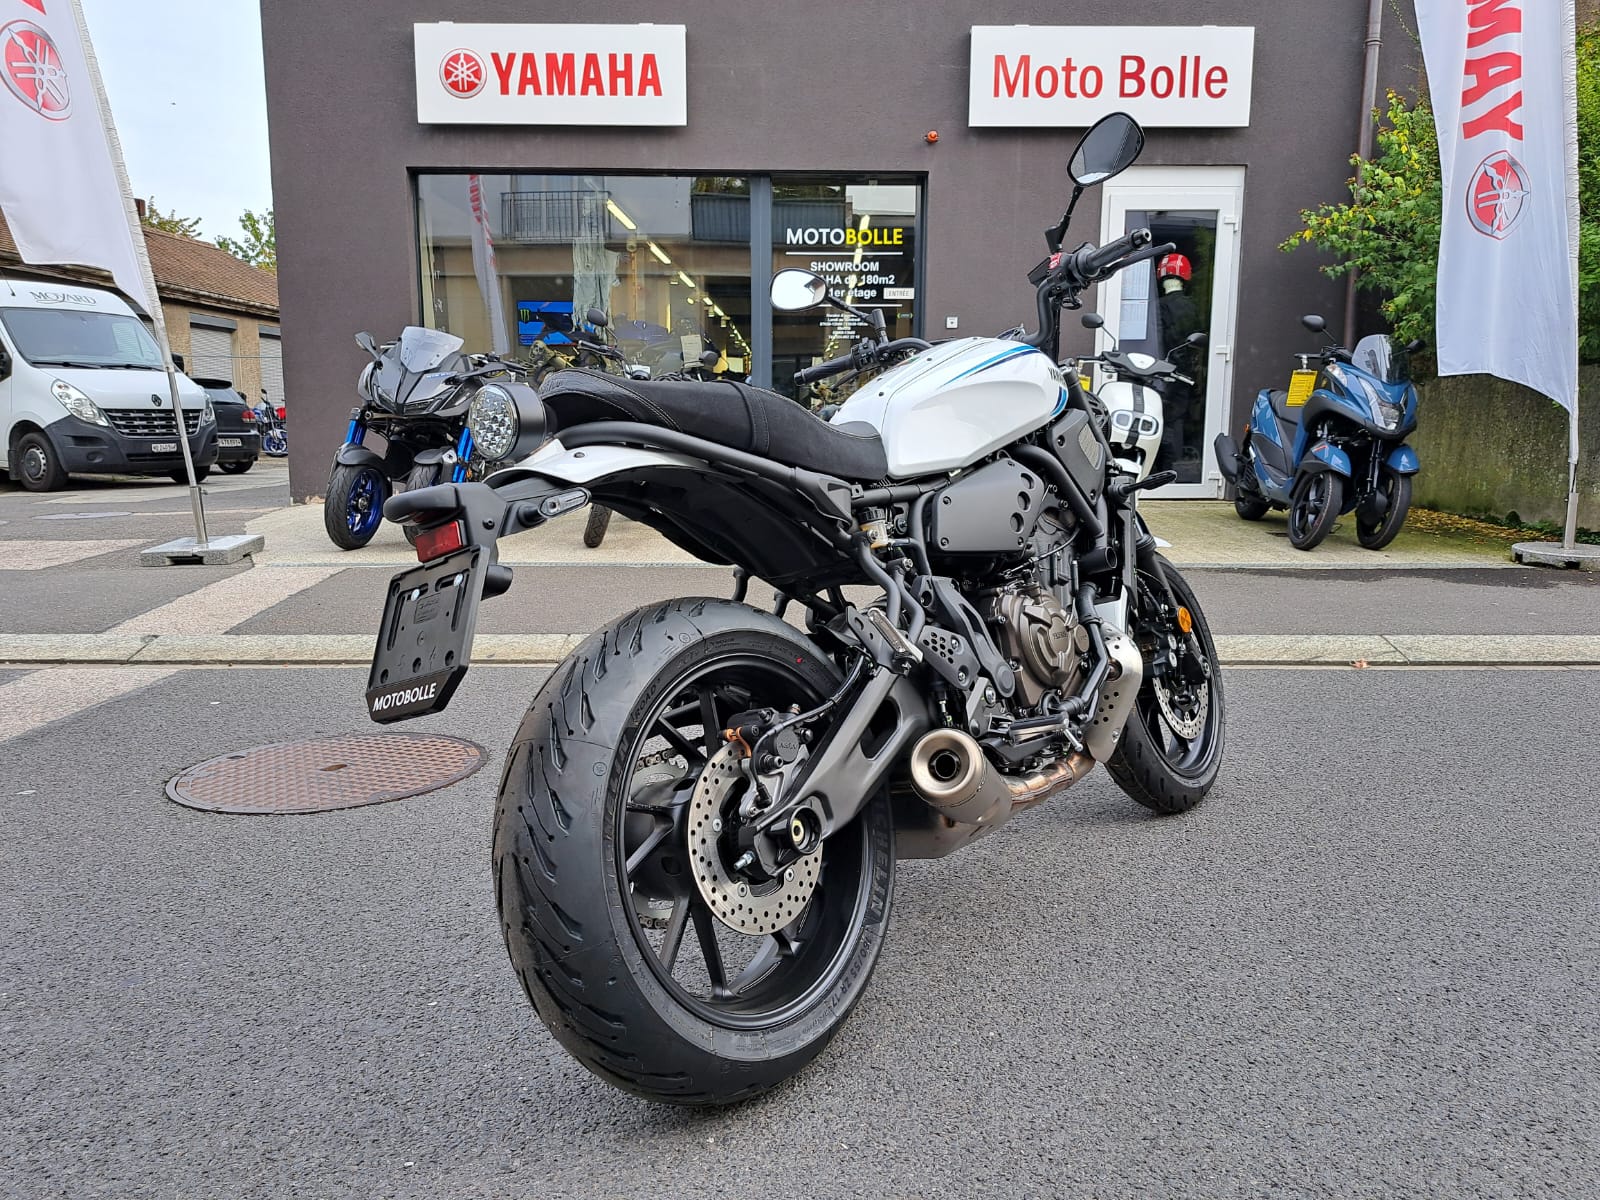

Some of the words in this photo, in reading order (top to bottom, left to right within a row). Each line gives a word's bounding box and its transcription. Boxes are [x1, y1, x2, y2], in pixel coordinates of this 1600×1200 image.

[490, 52, 663, 97] YAMAHA
[993, 54, 1104, 99] Moto
[1119, 54, 1229, 99] Bolle
[786, 228, 903, 245] MOTOBOLLE
[810, 261, 880, 272] SHOWROOM
[860, 273, 896, 285] 180m2
[29, 291, 97, 306] MOYARD
[828, 287, 845, 298] 1er
[372, 682, 437, 712] MOTOBOLLE
